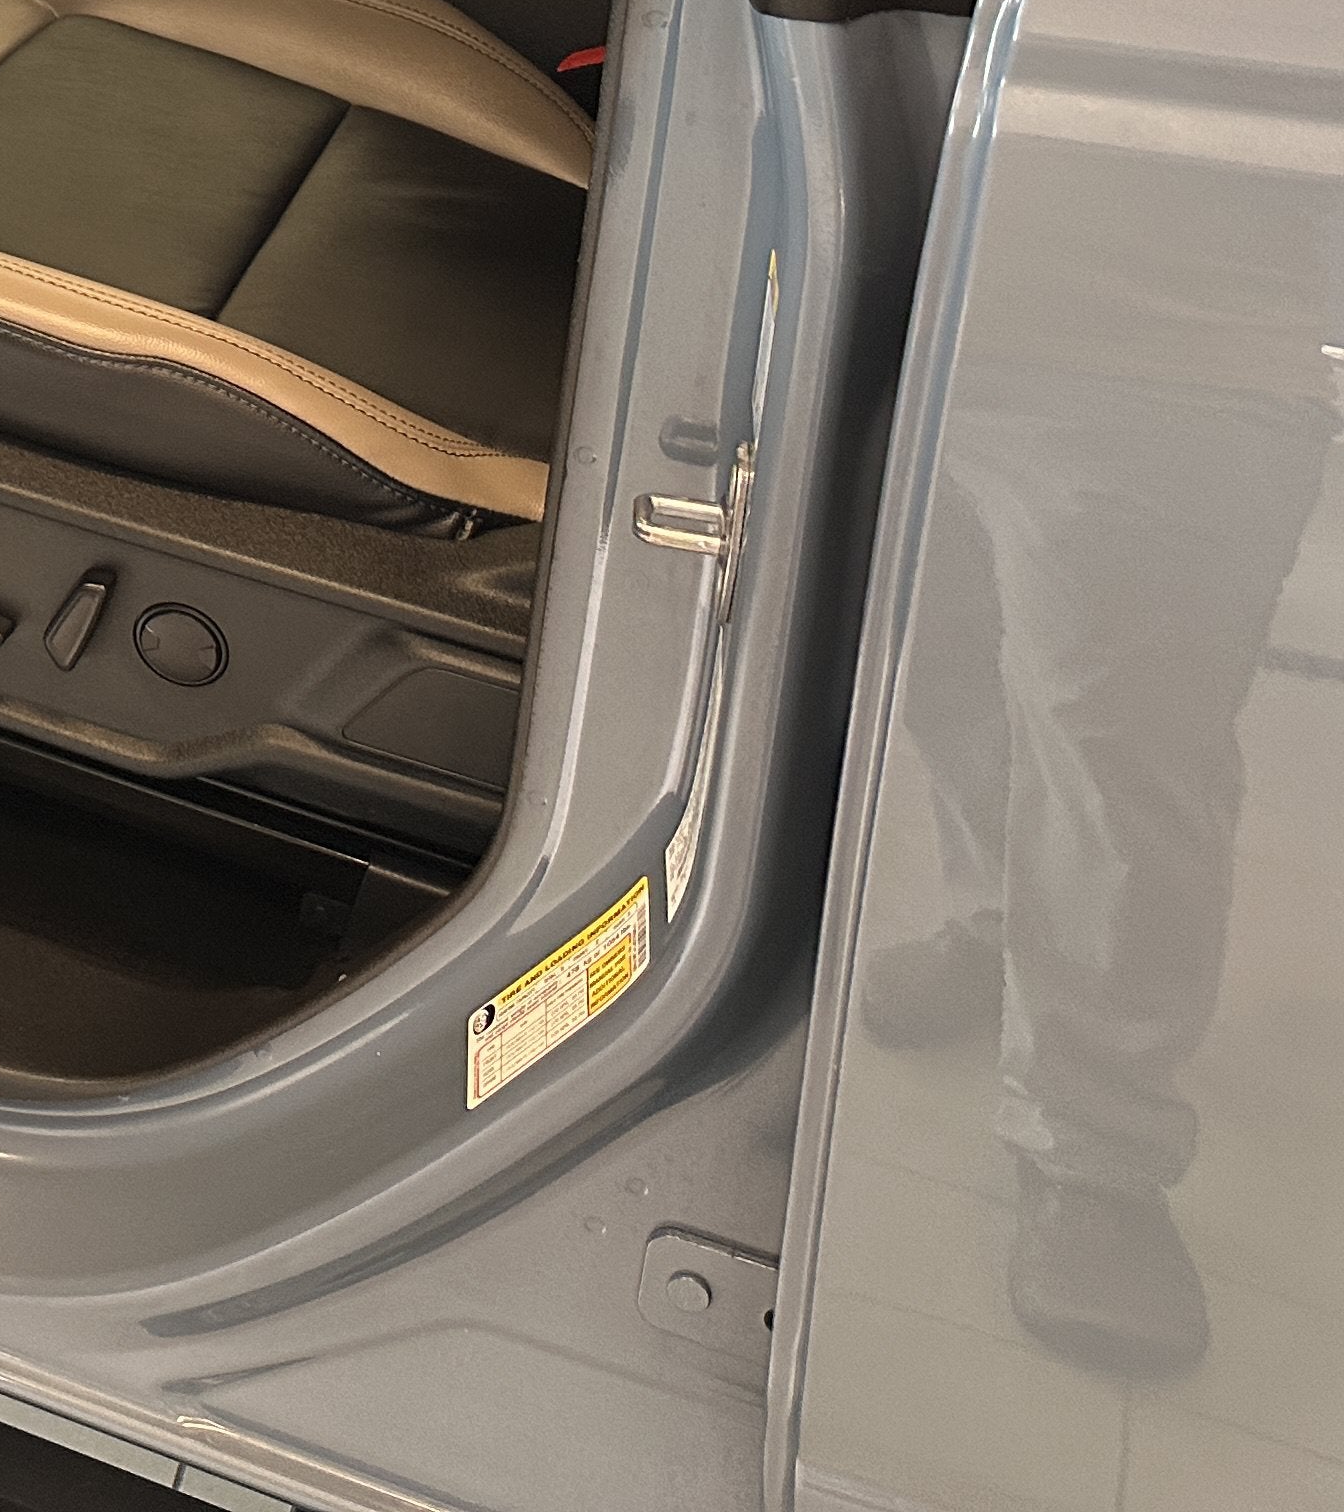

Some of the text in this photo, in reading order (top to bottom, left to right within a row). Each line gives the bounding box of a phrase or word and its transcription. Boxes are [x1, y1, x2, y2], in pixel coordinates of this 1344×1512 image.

[501, 884, 645, 1004] TIRE AND LOADING INFORMATION
